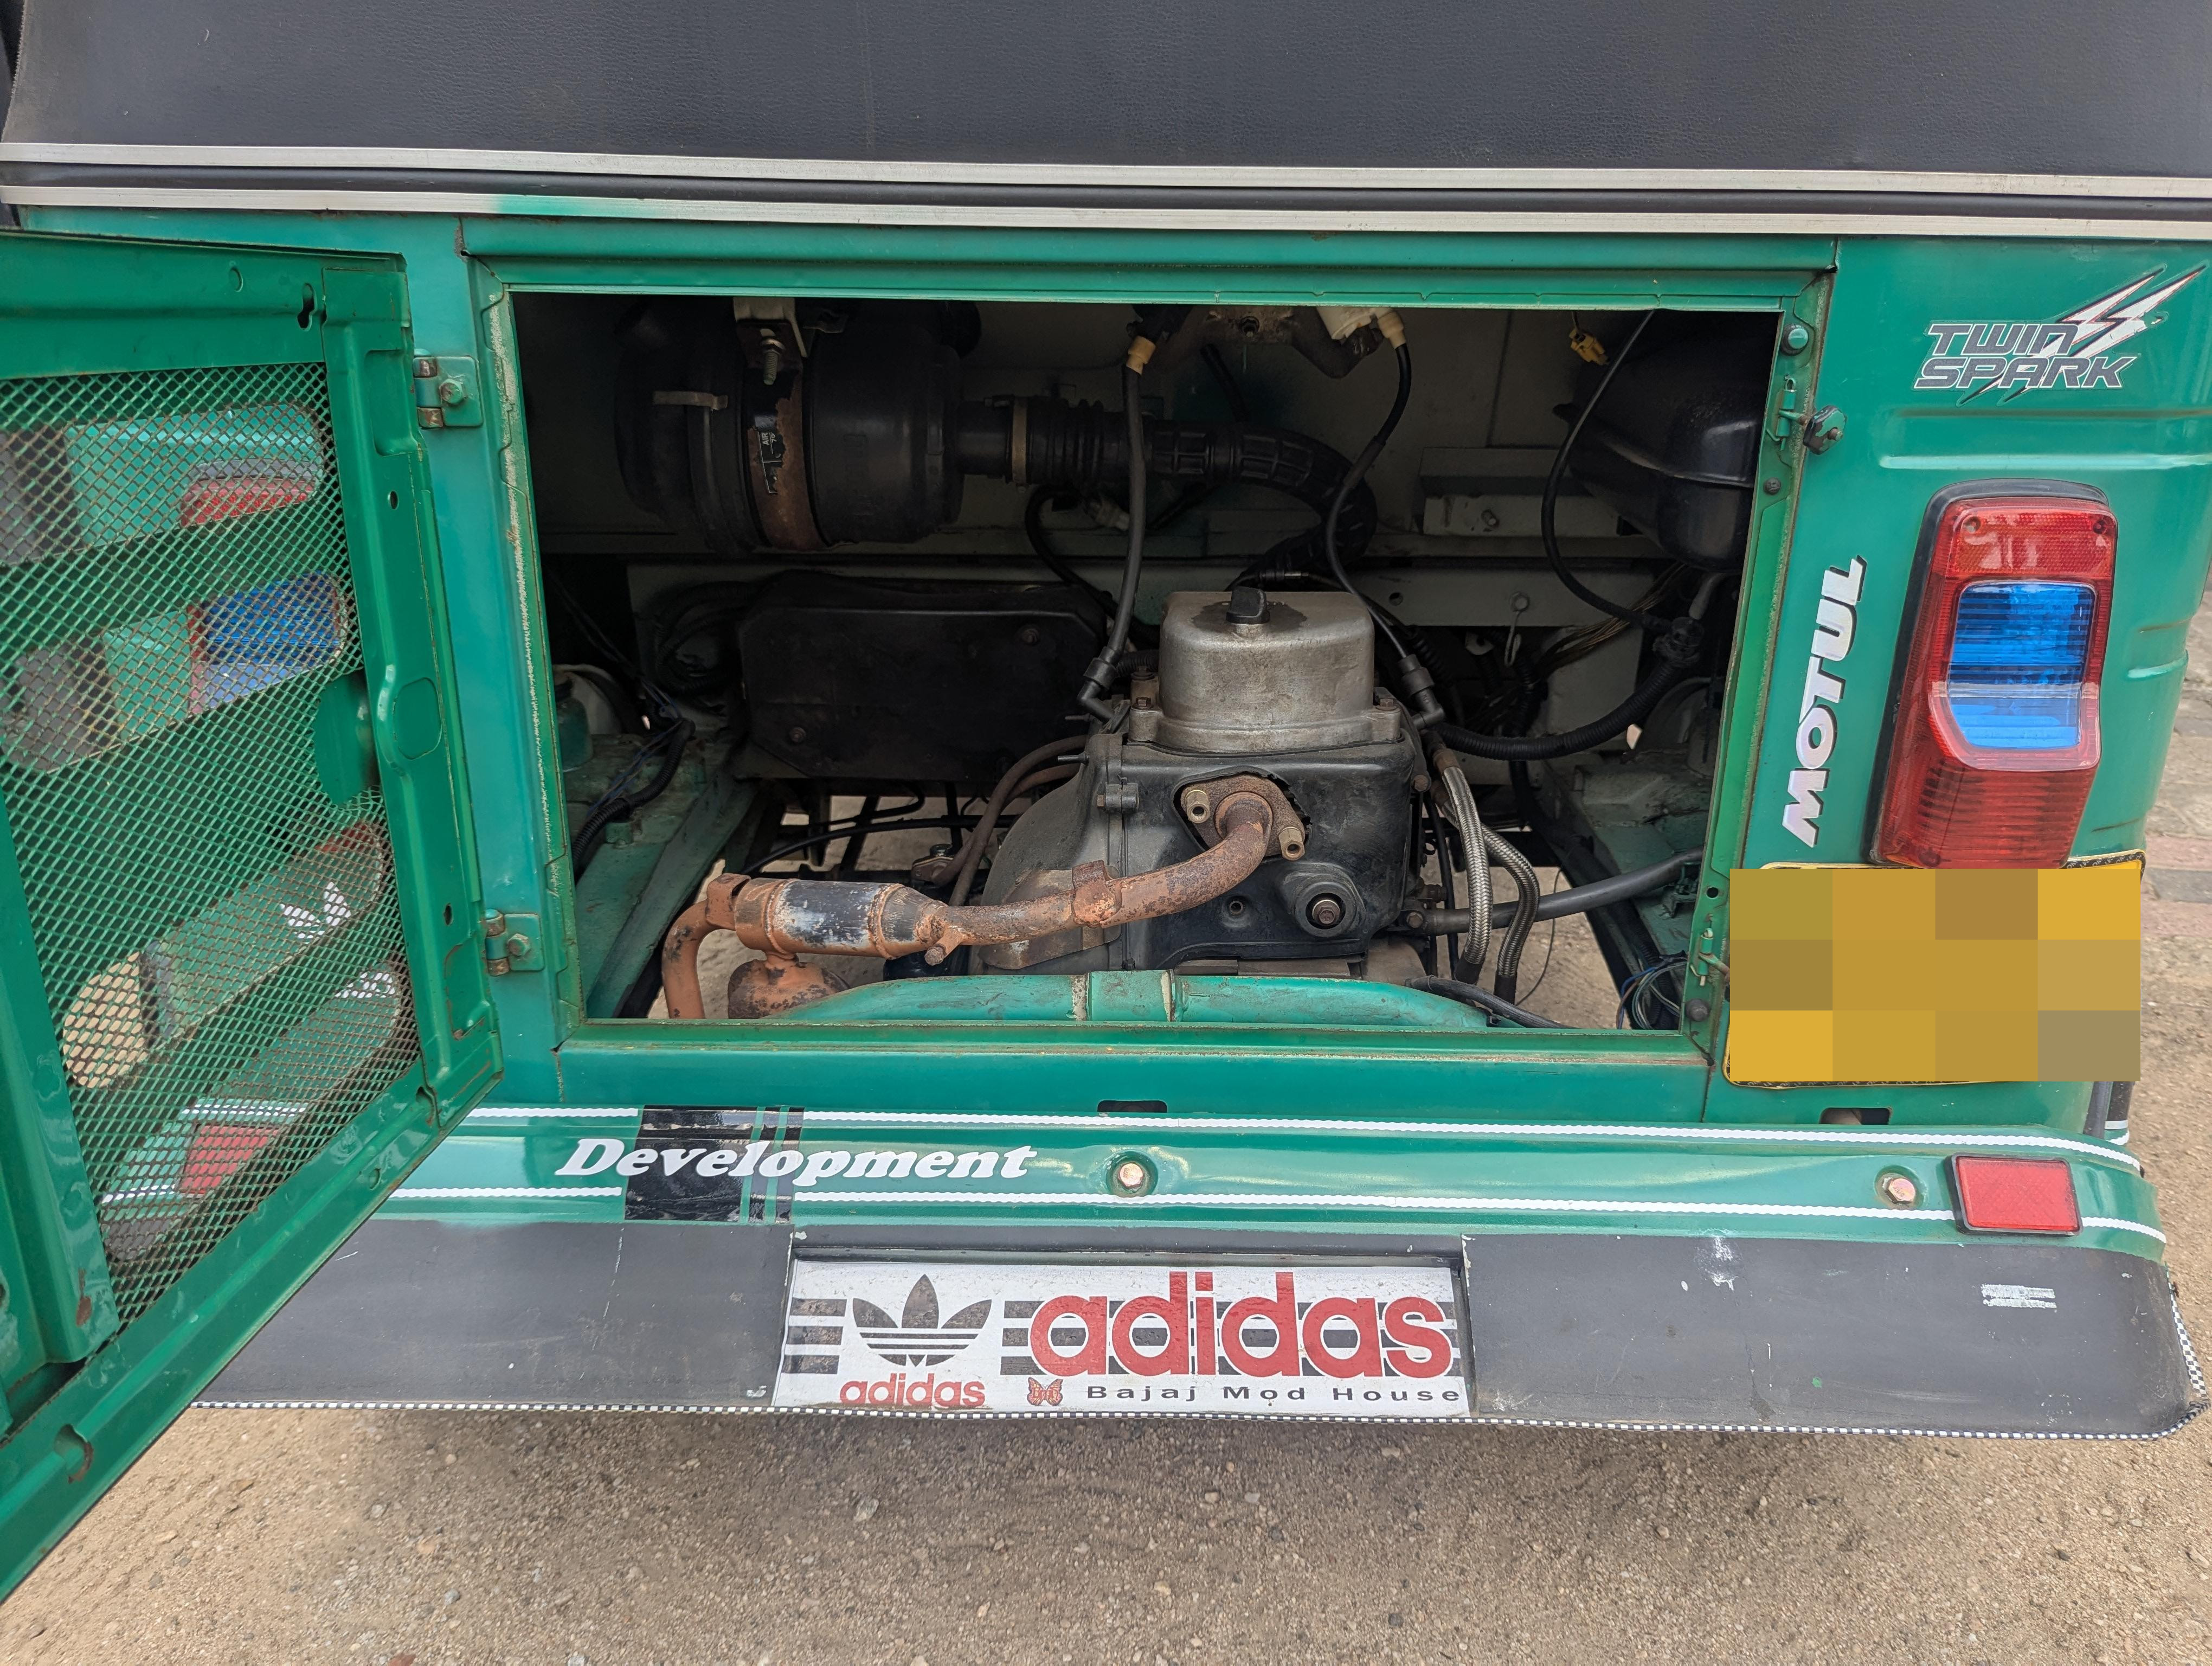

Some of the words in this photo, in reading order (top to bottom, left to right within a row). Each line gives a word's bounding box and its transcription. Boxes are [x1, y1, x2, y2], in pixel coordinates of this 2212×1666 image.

[1927, 324, 2079, 356] TWIN
[1914, 356, 2137, 389] SPARK
[761, 433, 769, 445] AIR
[1782, 555, 1866, 848] MOTUL
[555, 1138, 1038, 1187] Development
[1030, 1271, 1451, 1379] adidas
[840, 1373, 986, 1407] adidas
[1087, 1386, 1195, 1402] Bajaj
[1223, 1386, 1304, 1400] Mod
[1333, 1388, 1459, 1401] House
